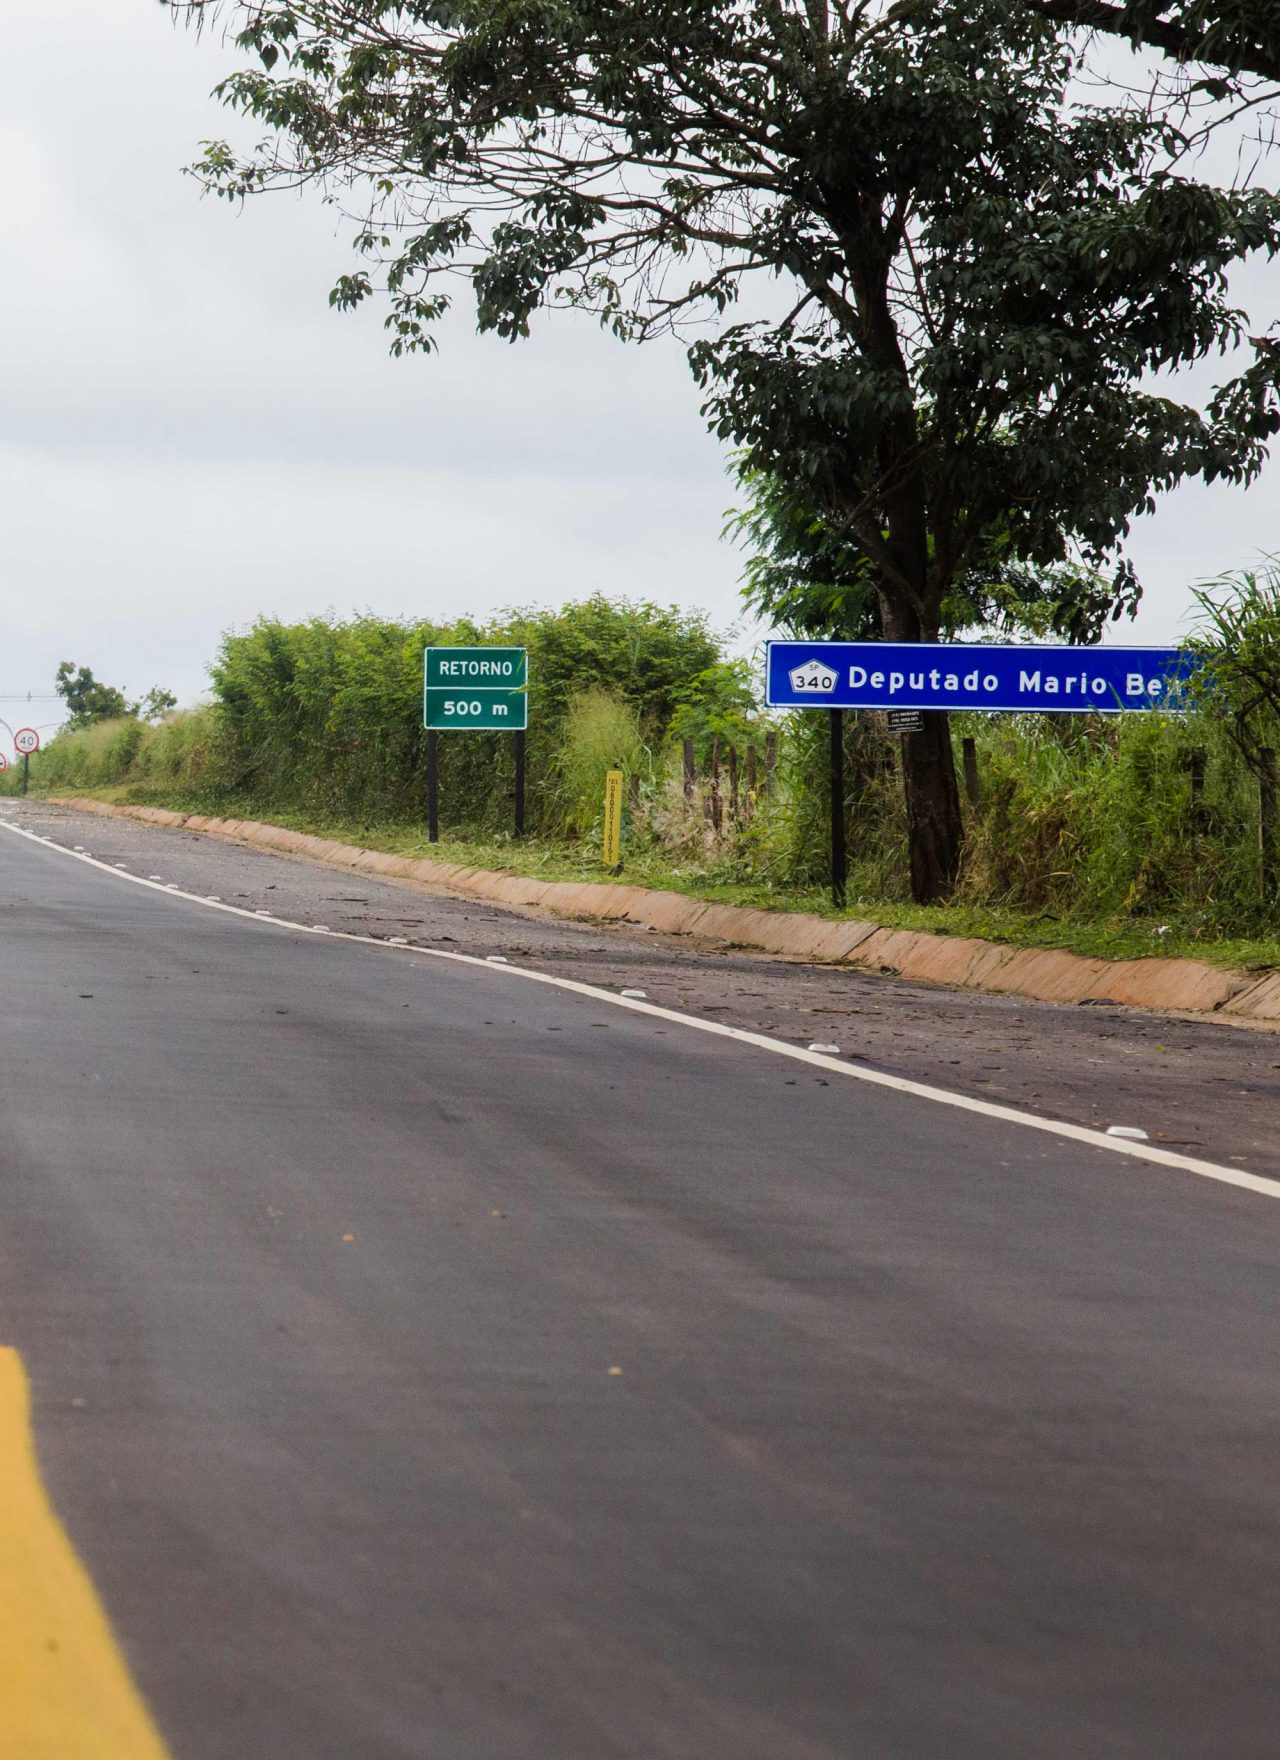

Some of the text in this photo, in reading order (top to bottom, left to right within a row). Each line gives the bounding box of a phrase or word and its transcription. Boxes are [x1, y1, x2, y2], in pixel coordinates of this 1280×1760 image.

[439, 661, 513, 675] RETORNO
[795, 675, 832, 689] 340
[849, 666, 999, 695] Deputado
[1019, 670, 1107, 694] Mario
[443, 701, 508, 716] 500 m
[20, 736, 34, 746] 40
